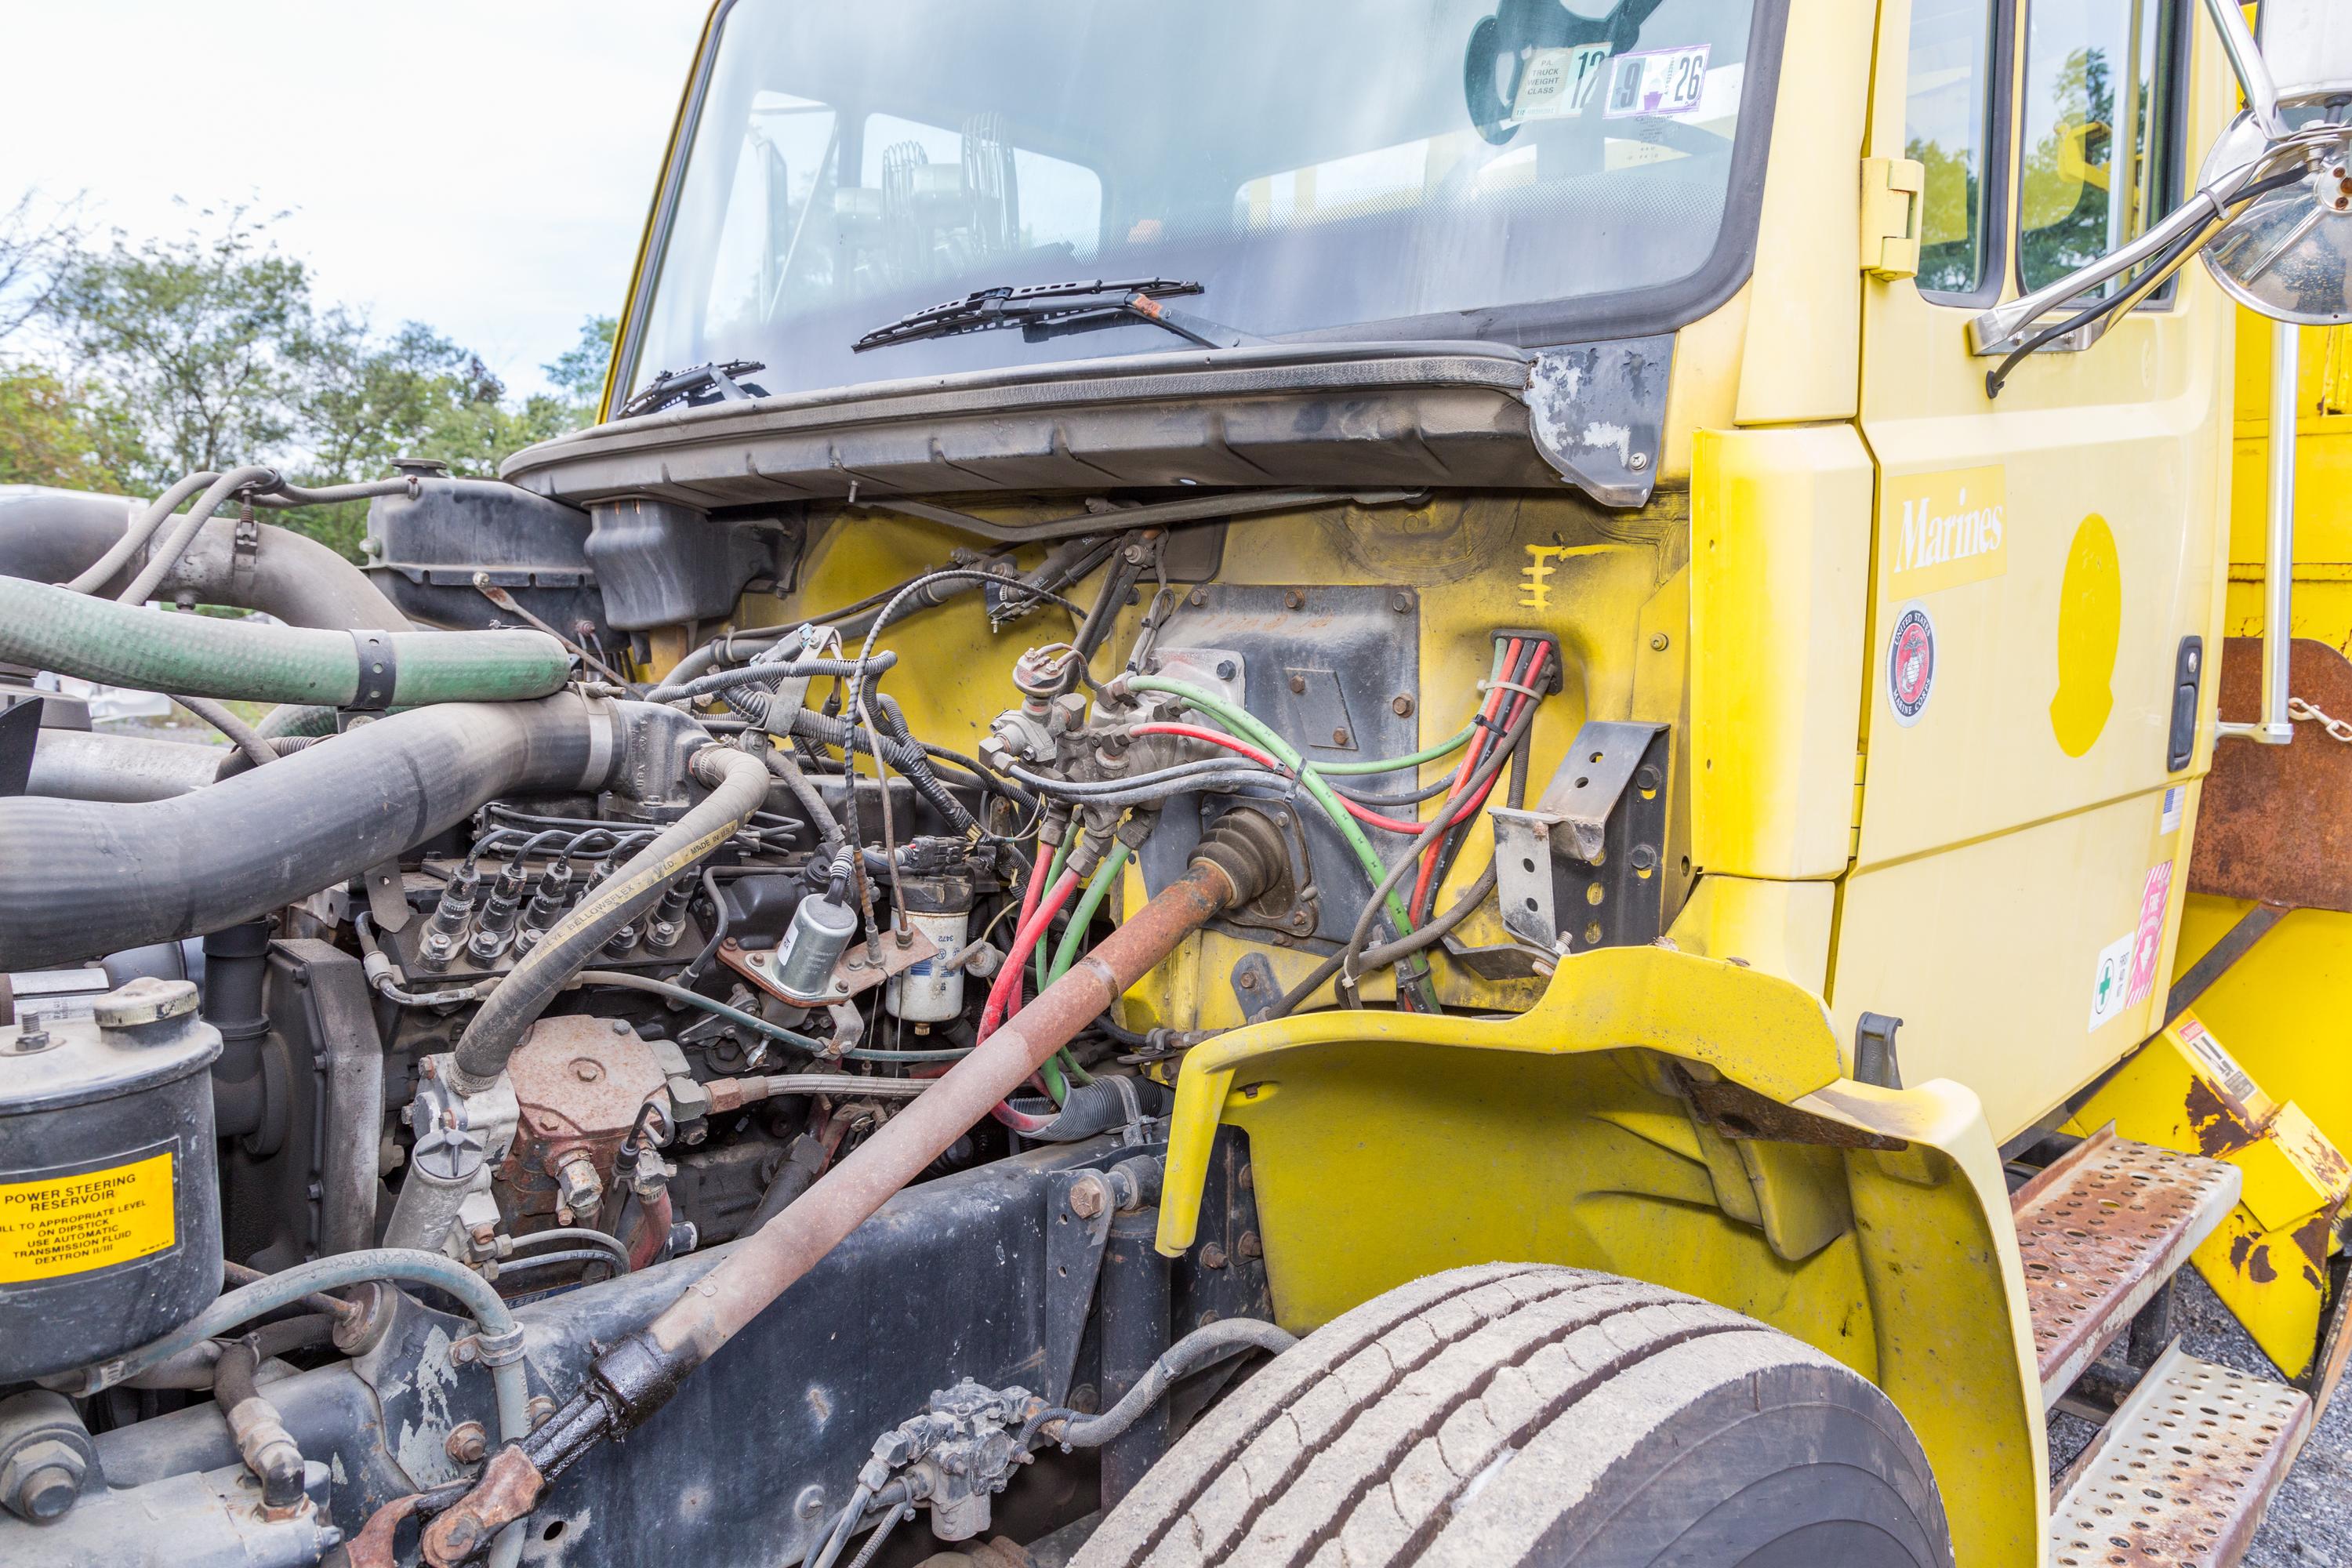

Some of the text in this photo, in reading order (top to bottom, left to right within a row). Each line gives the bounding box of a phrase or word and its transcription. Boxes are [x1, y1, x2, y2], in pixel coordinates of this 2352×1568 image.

[1570, 51, 1606, 109] 12
[1621, 63, 1641, 108] 9
[1674, 55, 1703, 102] 26
[1894, 487, 2003, 574] Marines
[1894, 612, 1931, 646] UNITED STATES
[1893, 677, 1932, 715] MARINE CORPS
[567, 884, 635, 931] BELLOWSFLEX
[691, 839, 710, 855] MADE
[5, 1174, 136, 1204] POWER STEERING
[31, 1189, 115, 1212] RESERVOIR
[39, 1209, 114, 1228] APPROPRIATE
[118, 1200, 147, 1213] LEVEL
[59, 1218, 109, 1235] DIPSTICK
[13, 1230, 132, 1258] TRANSMISSION FLUID
[27, 1225, 118, 1248] USE AUTOMATIC
[35, 1244, 114, 1265] DEXTRON II/III
